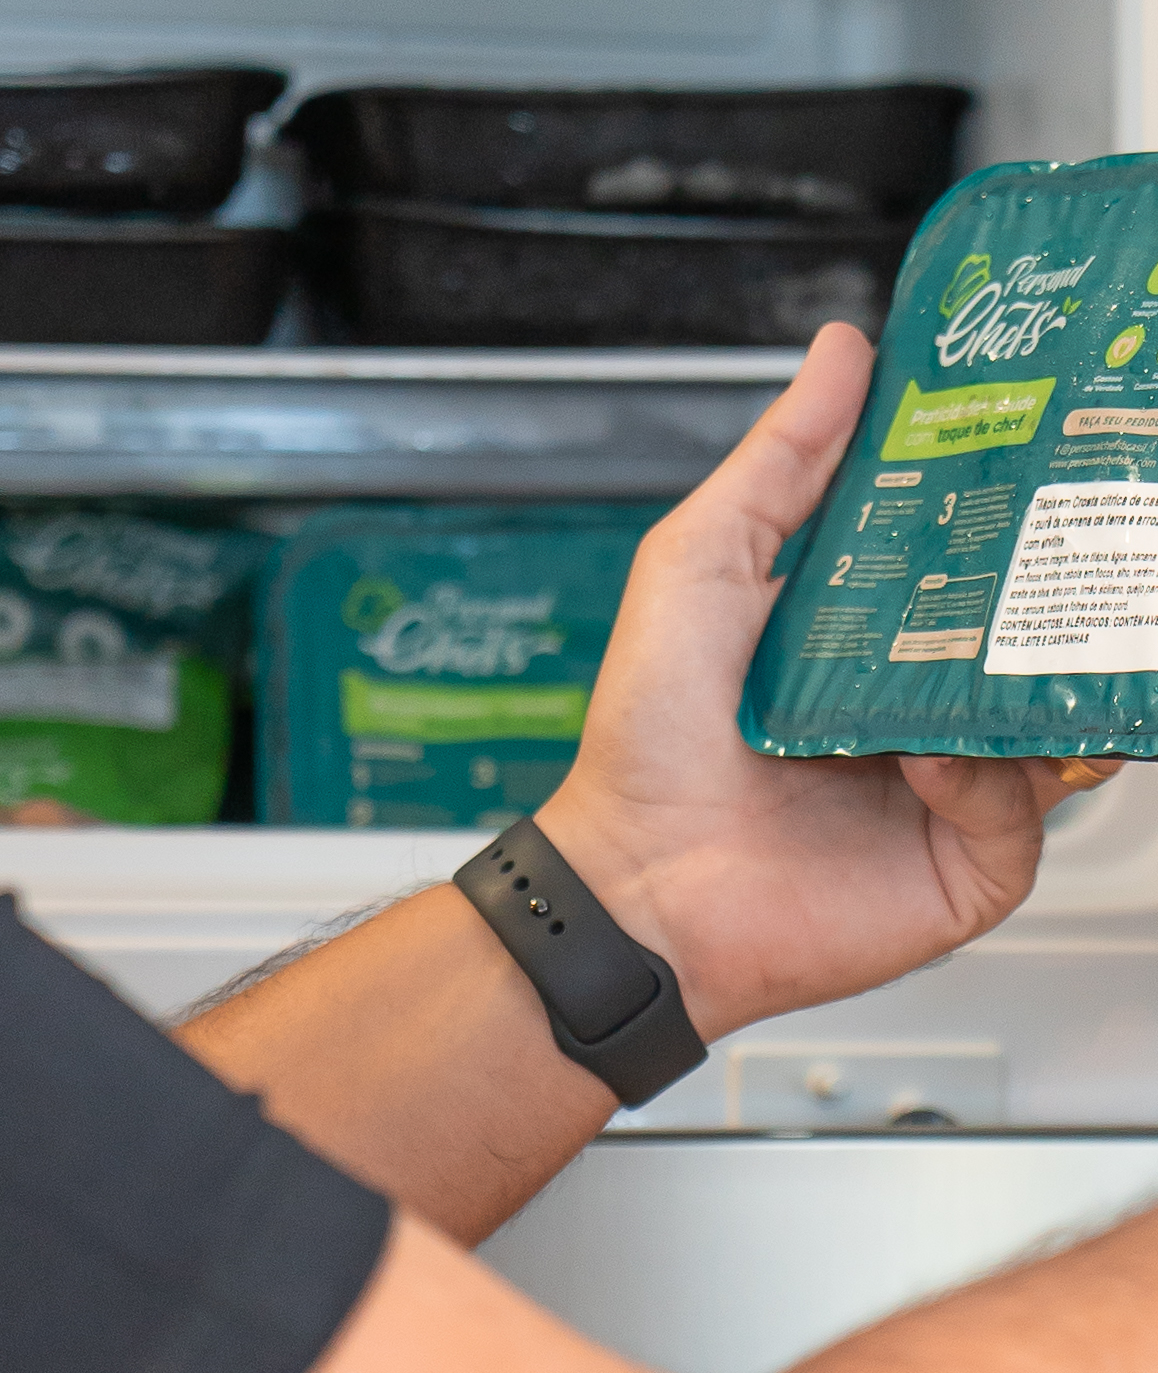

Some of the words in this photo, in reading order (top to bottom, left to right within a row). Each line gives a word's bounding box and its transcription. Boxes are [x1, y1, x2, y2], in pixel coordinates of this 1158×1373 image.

[1004, 255, 1096, 297] Personal
[937, 425, 972, 445] toque
[974, 419, 991, 436] de
[993, 414, 1027, 433] chef
[1078, 416, 1100, 429] FAÇA
[1102, 416, 1123, 426] SEU
[938, 492, 957, 525] 3
[1129, 494, 1142, 506] de
[856, 501, 874, 532] 1
[828, 555, 852, 586] 2
